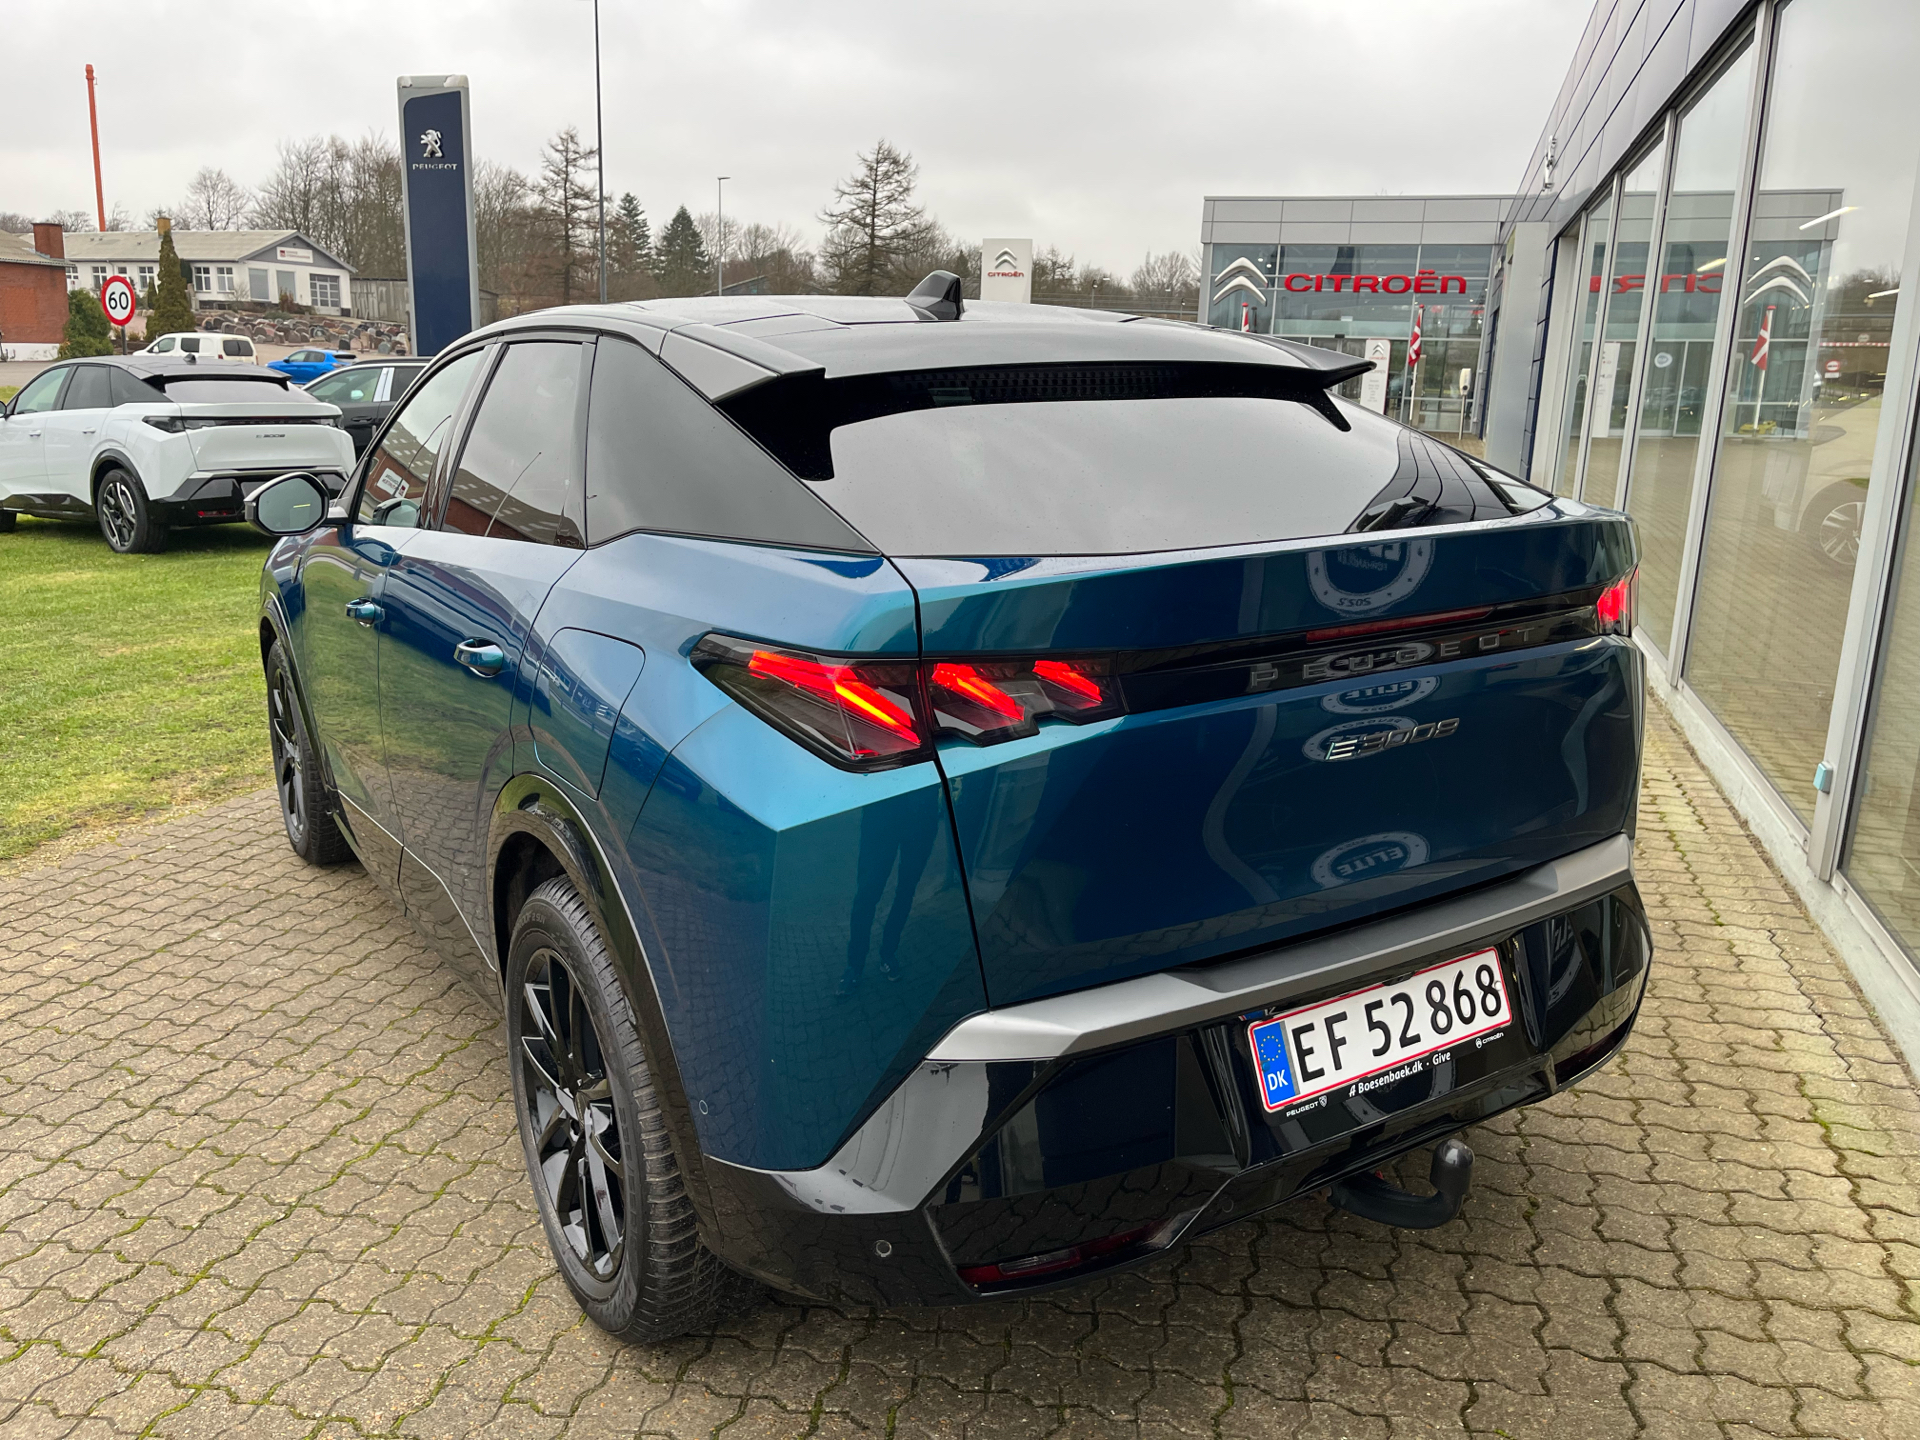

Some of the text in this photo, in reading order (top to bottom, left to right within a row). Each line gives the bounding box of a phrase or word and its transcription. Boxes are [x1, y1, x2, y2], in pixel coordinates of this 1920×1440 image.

[412, 163, 458, 171] PEUGEOT
[987, 270, 1025, 278] CITROËN
[1284, 269, 1467, 294] CITROËN
[108, 291, 130, 310] 60
[1251, 627, 1535, 688] PEUGEOT
[1291, 964, 1502, 1083] EF 52 868
[1482, 1032, 1505, 1044] CITROËN
[1267, 1069, 1289, 1092] DK
[1358, 1060, 1423, 1094] Boesenbaek.dk
[1432, 1051, 1452, 1066] Give
[1286, 1101, 1319, 1118] PEUGEOT
